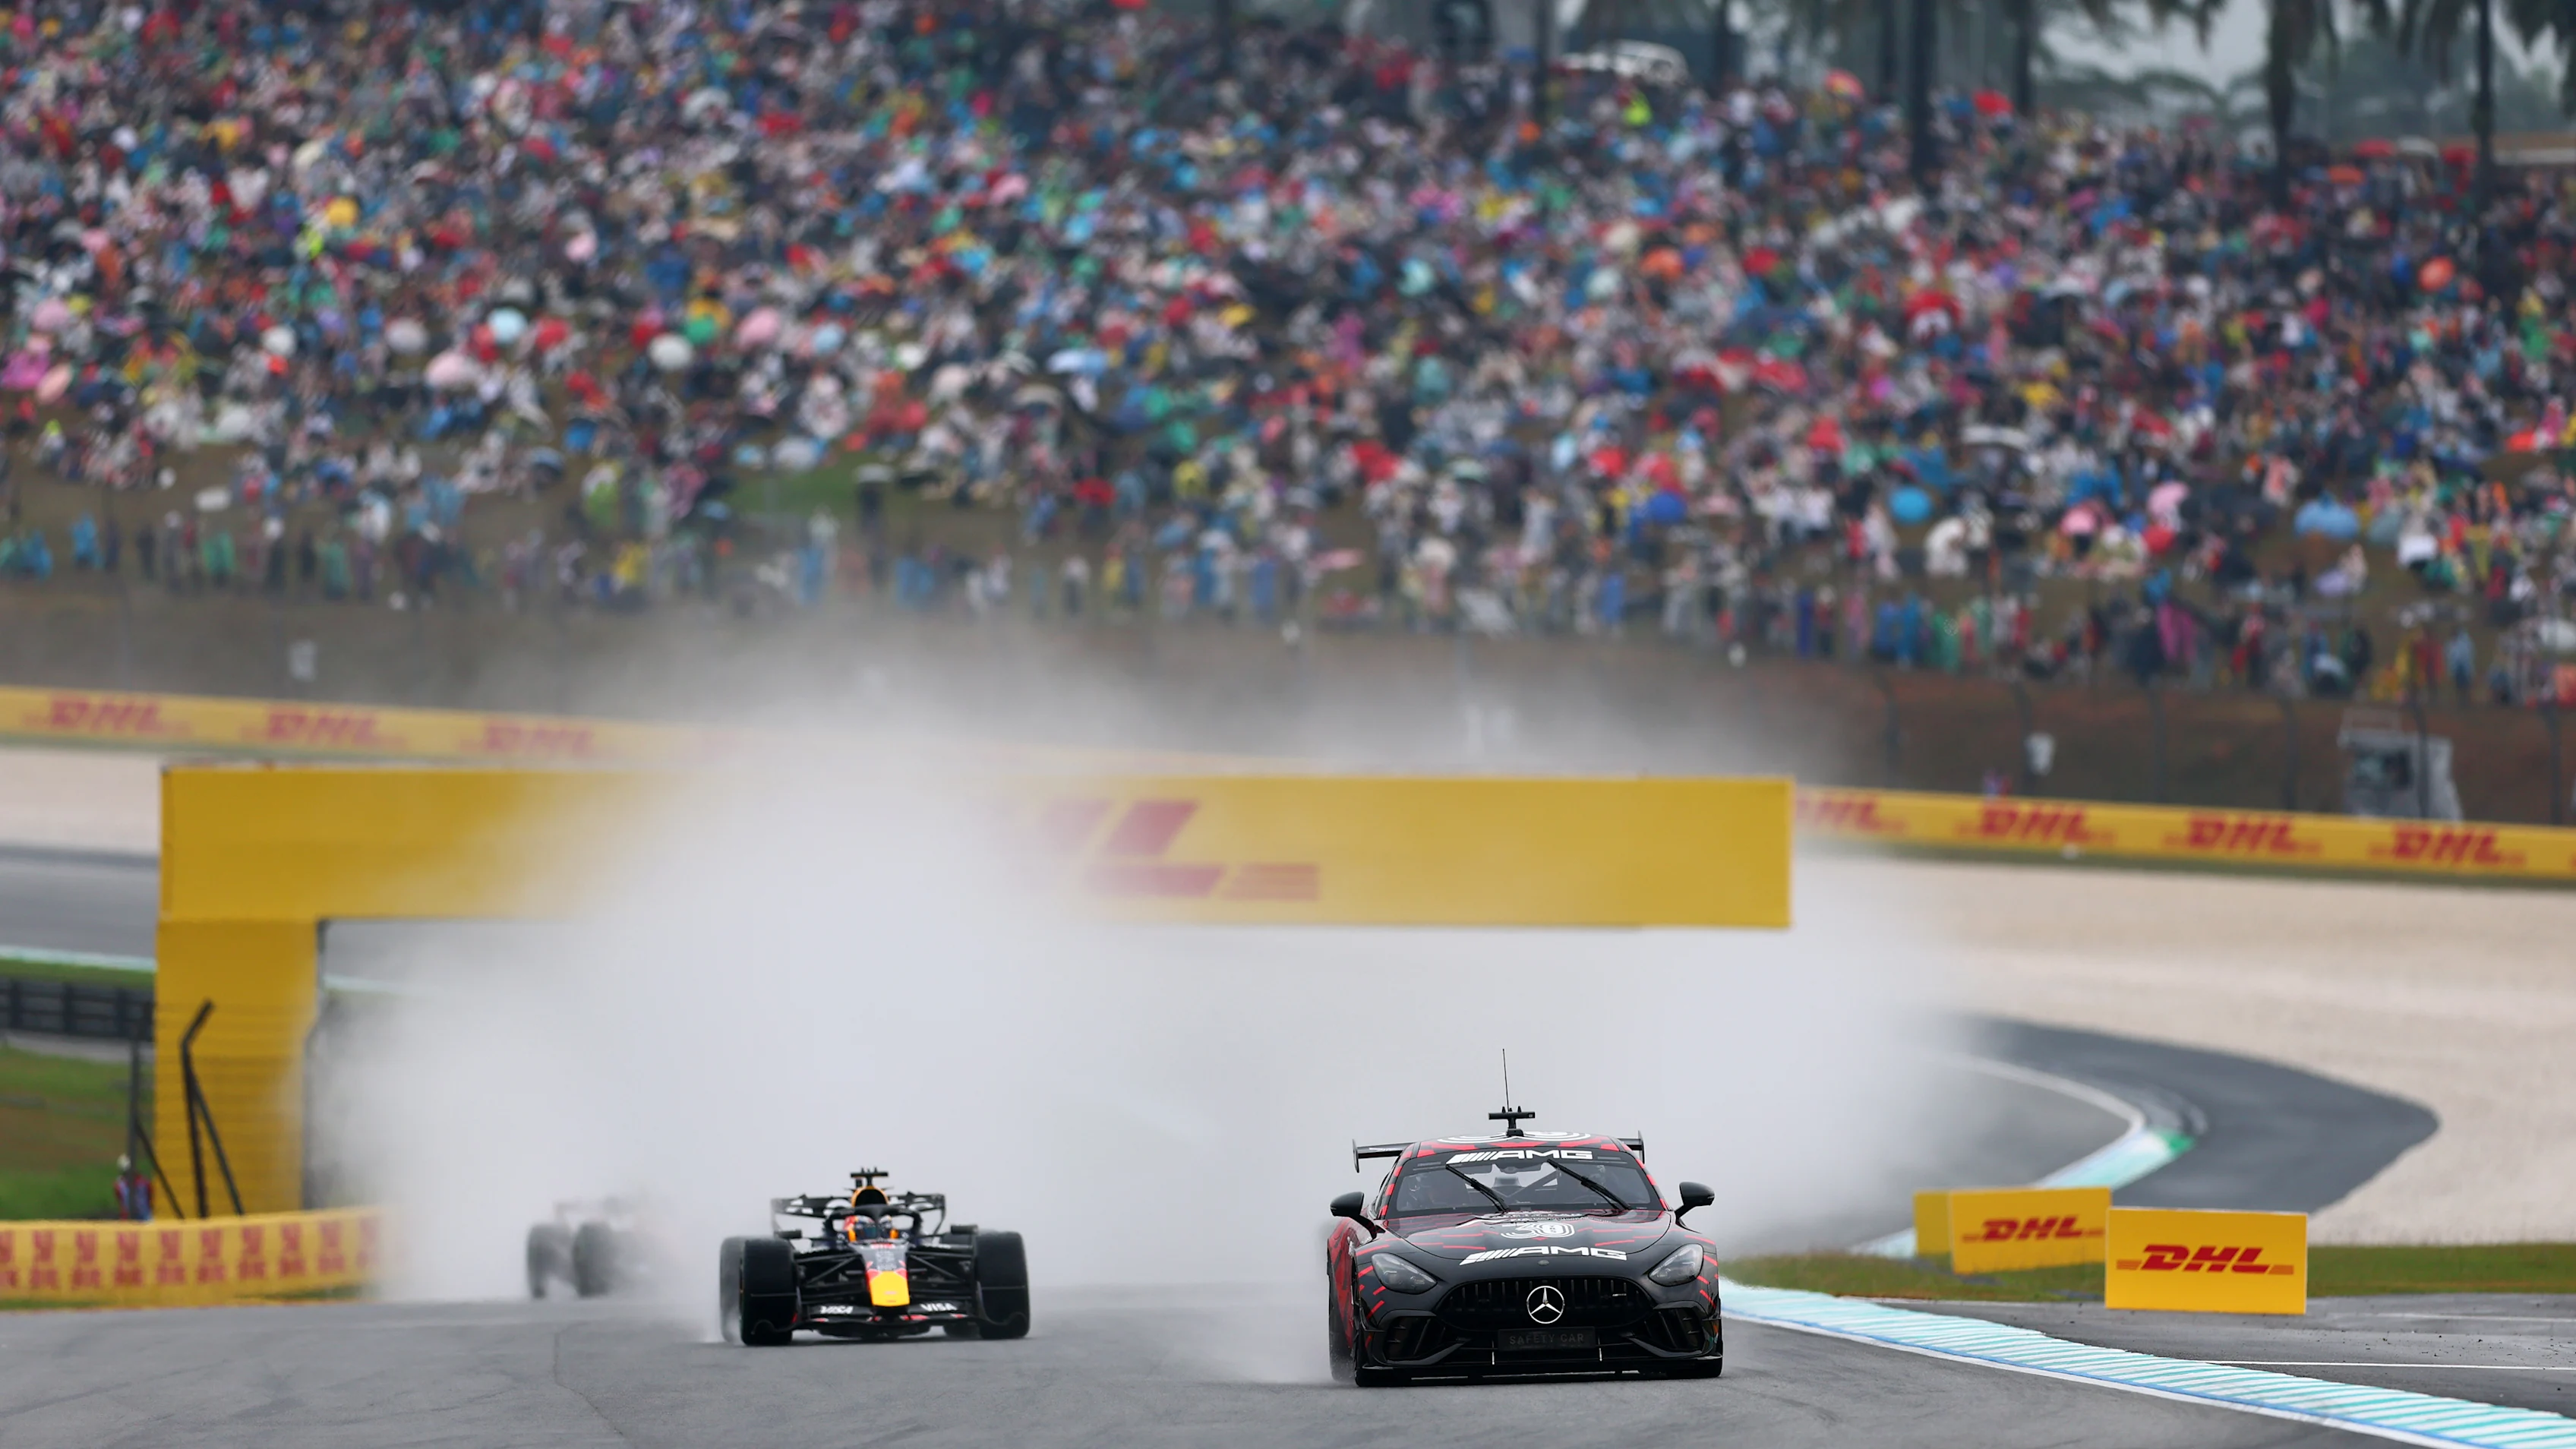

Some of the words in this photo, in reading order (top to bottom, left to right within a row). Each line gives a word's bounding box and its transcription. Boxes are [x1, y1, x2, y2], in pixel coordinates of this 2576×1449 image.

[50, 696, 162, 731] DHL
[268, 707, 378, 745] DHL
[1982, 805, 2090, 843] DHL
[2189, 815, 2298, 854] DHL
[2392, 826, 2502, 867] DHL
[1982, 1216, 2083, 1242] DHL
[2141, 1244, 2271, 1274] DHL
[820, 1305, 854, 1315] VISA
[920, 1302, 958, 1312] VISA
[1509, 1334, 1555, 1345] SAFETY
[1560, 1333, 1584, 1343] CAR
